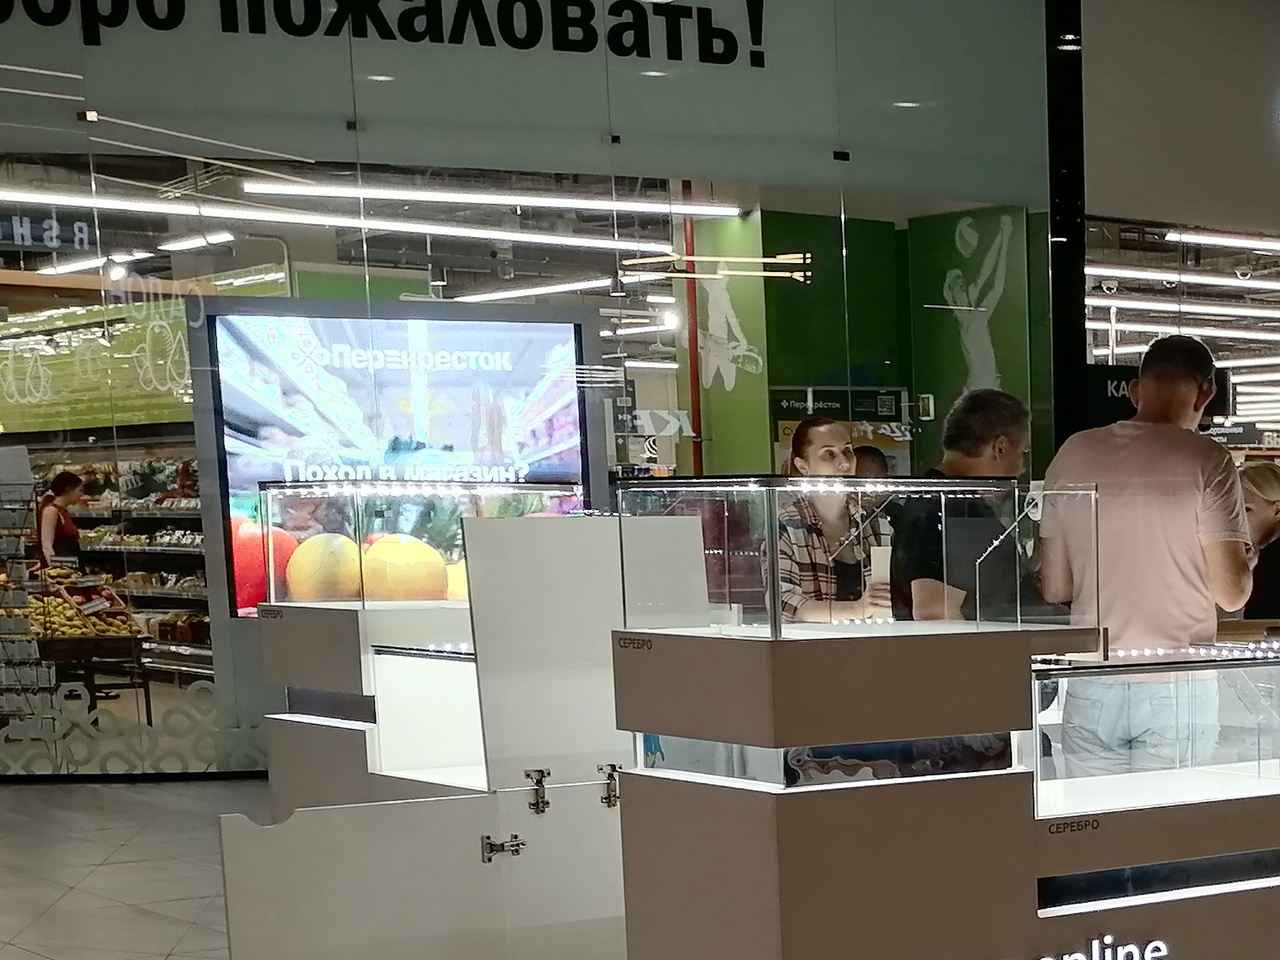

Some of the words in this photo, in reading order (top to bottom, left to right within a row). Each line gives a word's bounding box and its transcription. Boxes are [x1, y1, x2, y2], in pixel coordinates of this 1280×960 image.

[1107, 379, 1130, 398] КА
[618, 637, 653, 650] СЕРЕБРО
[1048, 819, 1100, 834] СЕРЕБРО
